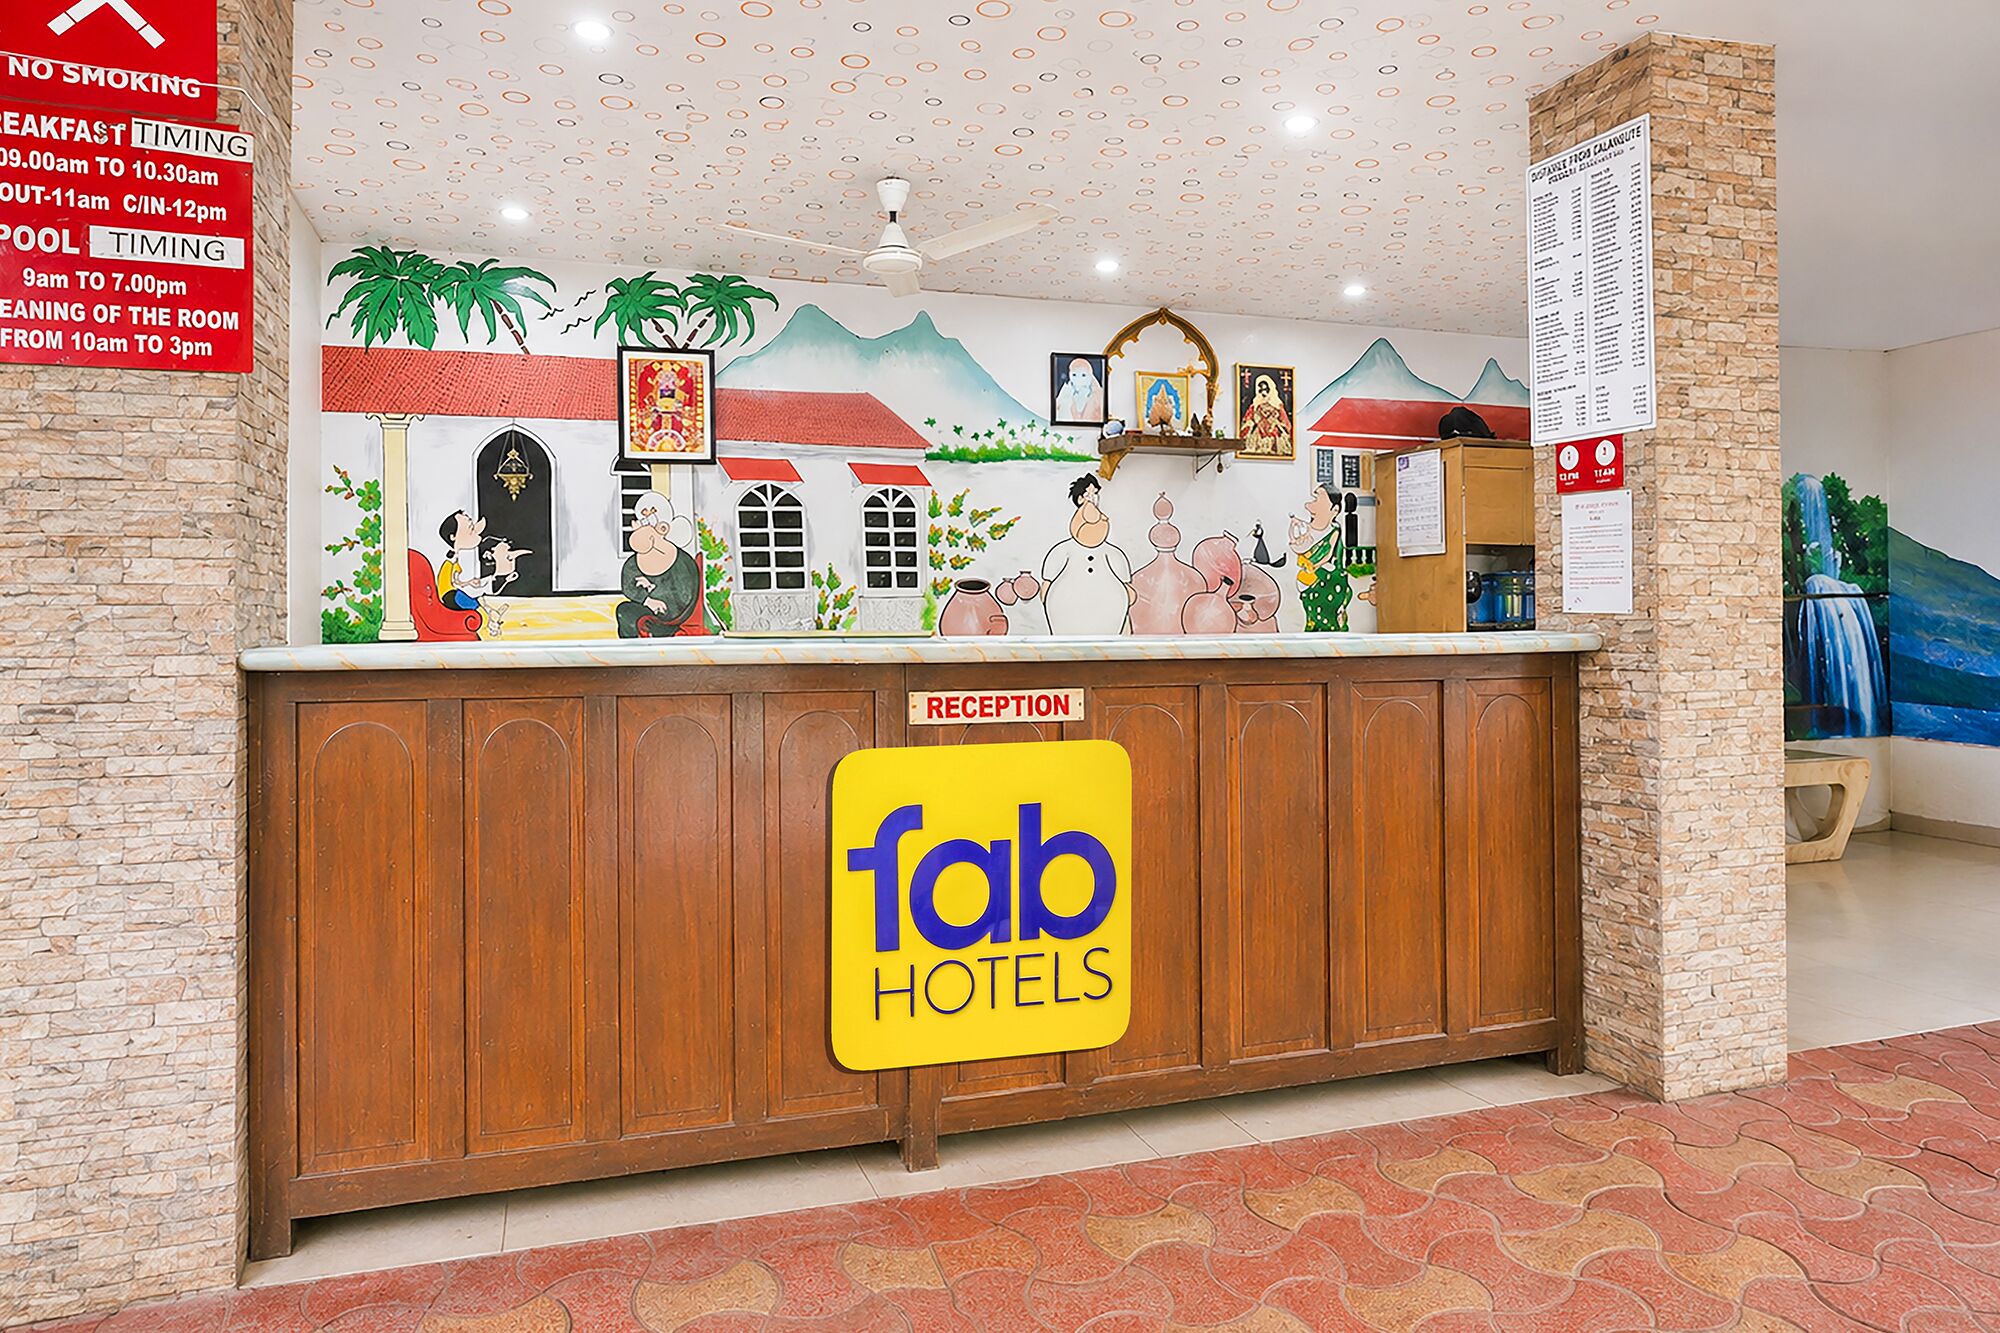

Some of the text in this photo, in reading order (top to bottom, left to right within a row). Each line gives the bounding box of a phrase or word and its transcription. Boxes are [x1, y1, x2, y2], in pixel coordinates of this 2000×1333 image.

[9, 57, 200, 97] NO SMOKING
[0, 112, 248, 157] EAKFAST TIMING
[0, 147, 218, 185] 09.00am TO 10.30am
[0, 182, 226, 223] OUT-11am C/IN-12pm
[0, 224, 224, 261] POOL TIMING
[23, 268, 186, 296] 9am TO 7.00pm
[0, 299, 238, 329] EANING OF THE ROOM
[1, 328, 212, 360] FROM 10am TO 3pm
[926, 694, 1070, 719] RECEPTION
[847, 803, 1116, 952] fab
[875, 946, 1113, 1020] HOTELS
